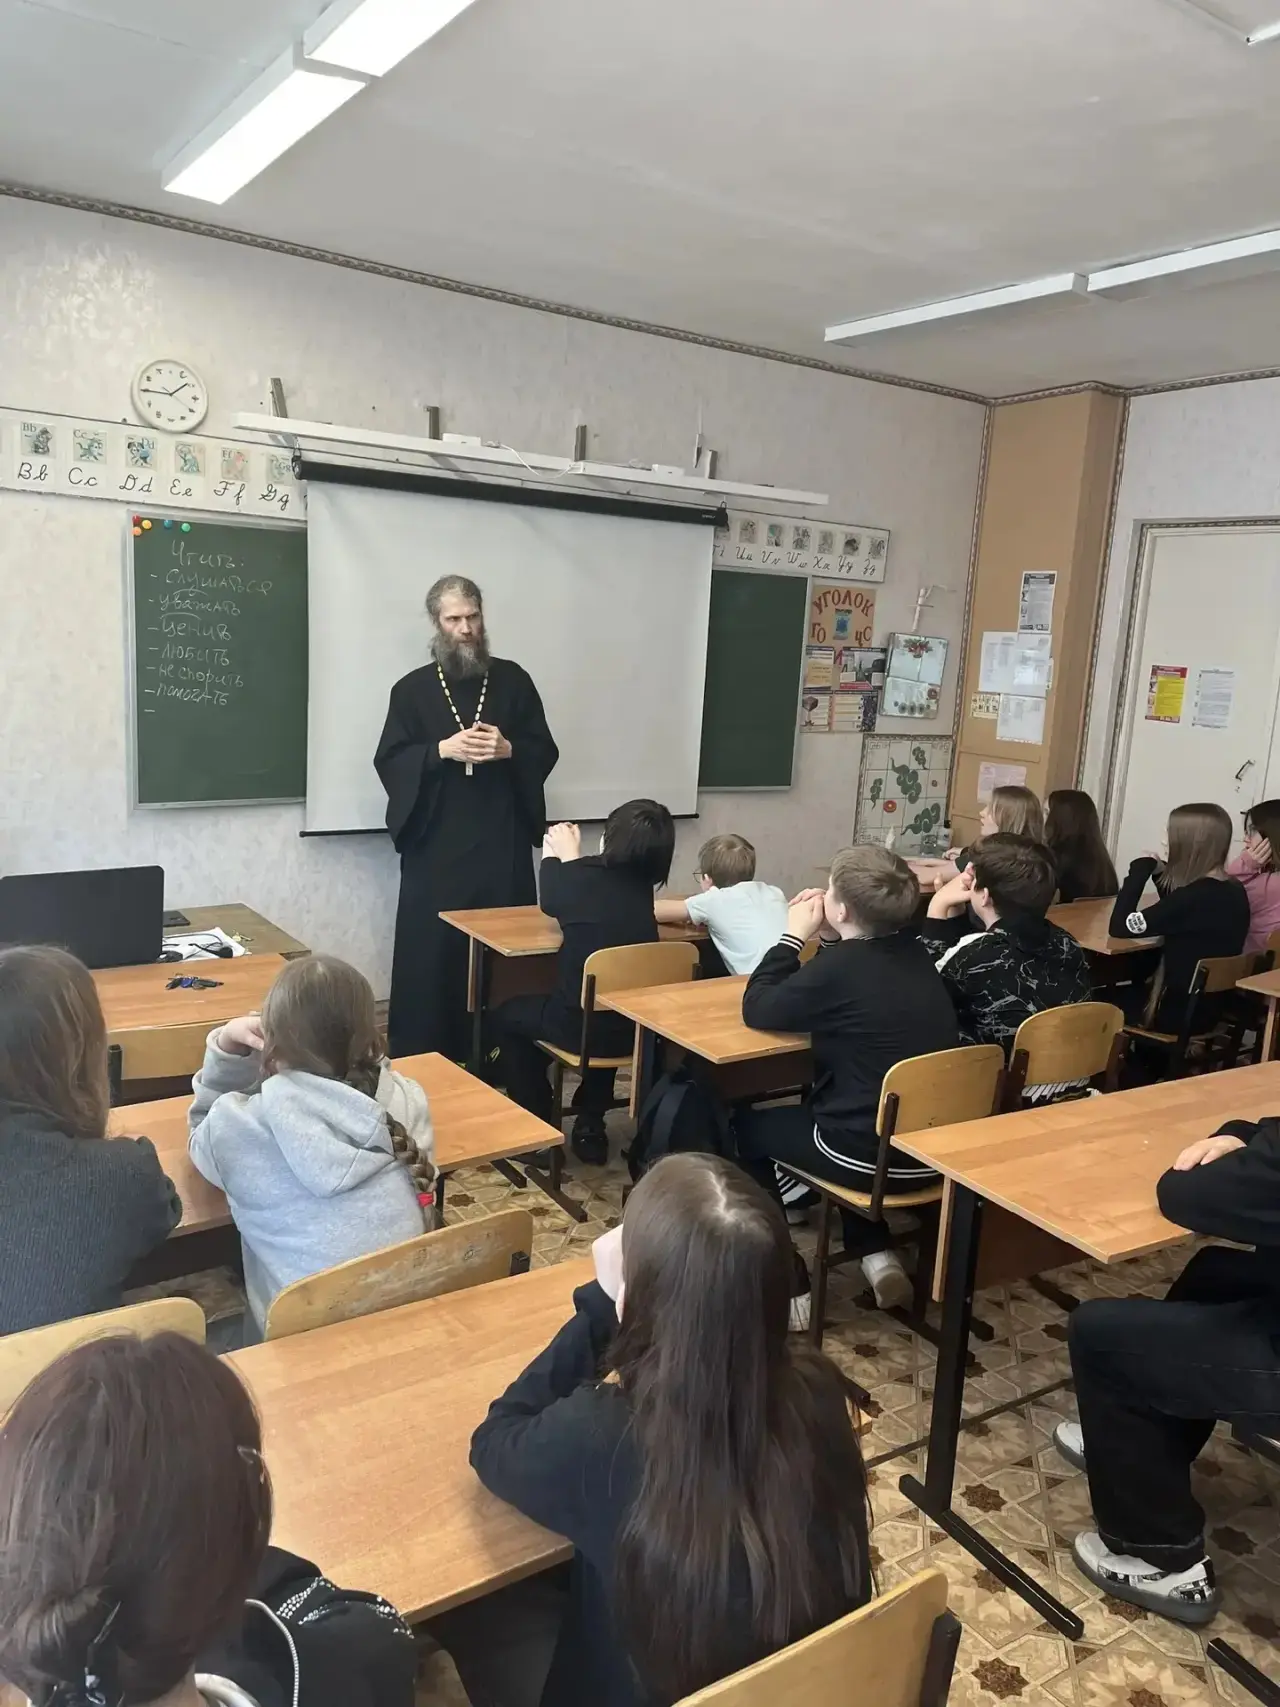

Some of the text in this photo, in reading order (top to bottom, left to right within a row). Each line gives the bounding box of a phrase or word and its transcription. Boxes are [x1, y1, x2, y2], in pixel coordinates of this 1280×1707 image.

[17, 461, 49, 481] Bb
[68, 466, 98, 487] Cc
[118, 473, 153, 493] Dd
[169, 478, 193, 497] Ee
[811, 588, 874, 618] УГОЛОК
[811, 622, 826, 644] ГО
